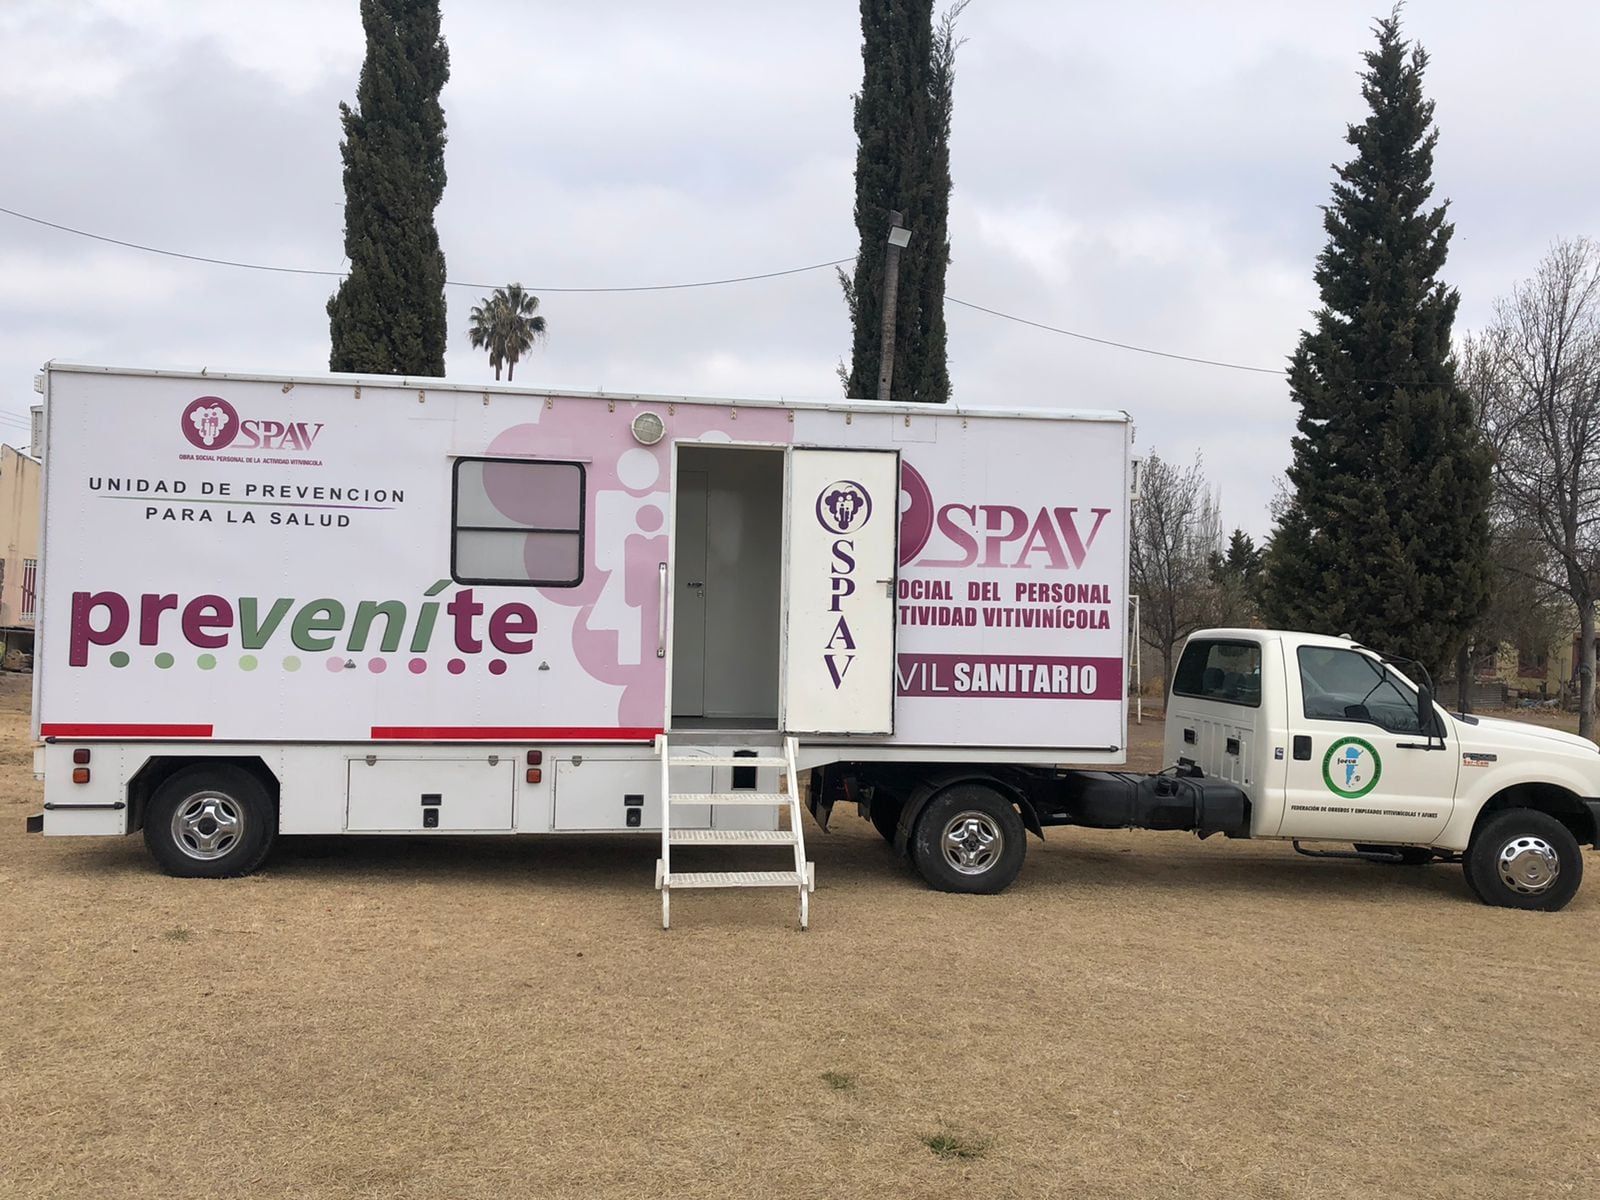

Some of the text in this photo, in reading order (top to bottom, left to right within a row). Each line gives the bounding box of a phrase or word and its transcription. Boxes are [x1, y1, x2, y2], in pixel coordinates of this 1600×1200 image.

[89, 477, 404, 503] UNIDAD DE PREVENCION
[146, 507, 350, 527] PARA LA SALUD
[968, 581, 1001, 601] DEL
[1015, 582, 1111, 604] PERSONAL
[983, 605, 1110, 630] VITIVINÍCOLA
[954, 662, 1098, 695] SANITARIO
